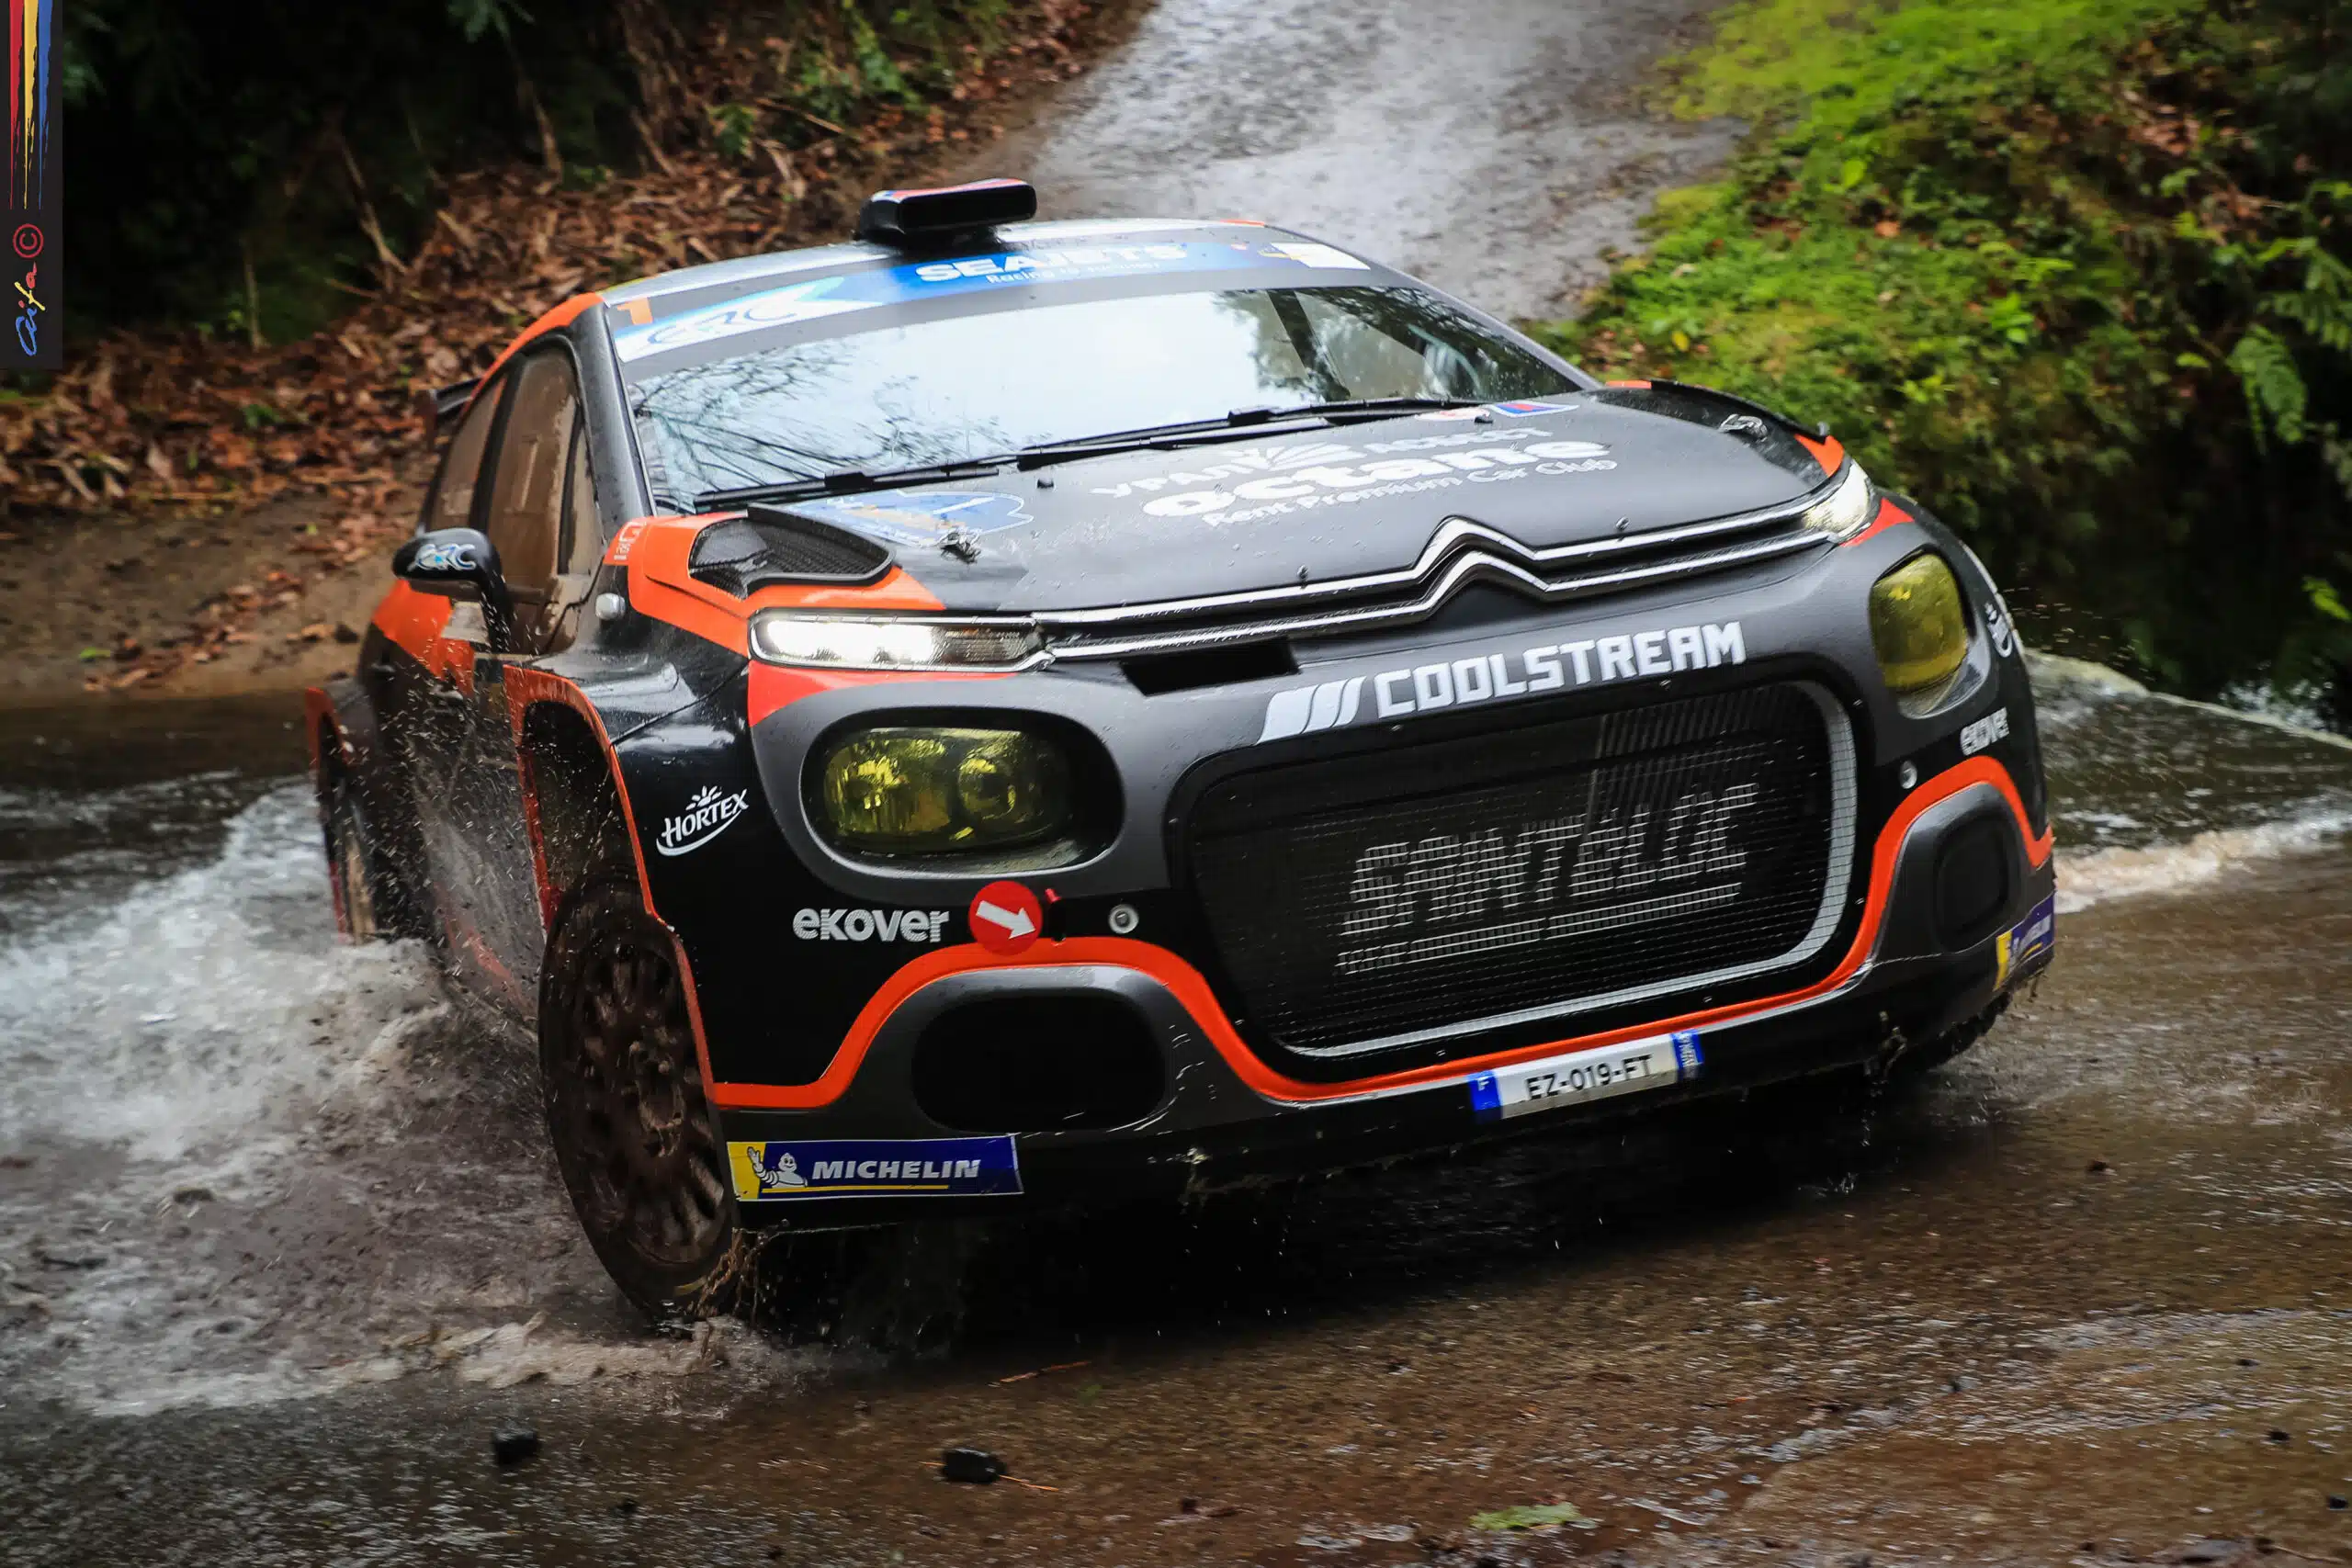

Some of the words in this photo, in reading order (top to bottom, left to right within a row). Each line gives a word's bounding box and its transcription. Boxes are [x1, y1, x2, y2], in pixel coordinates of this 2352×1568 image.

[1374, 621, 1747, 719] COOLSTREAM
[661, 788, 750, 847] HORTEX
[792, 907, 950, 943] ekover
[1476, 1076, 1490, 1091] F
[1524, 1054, 1654, 1101] EZ-019-FT
[811, 1158, 981, 1179] MICHELIN
